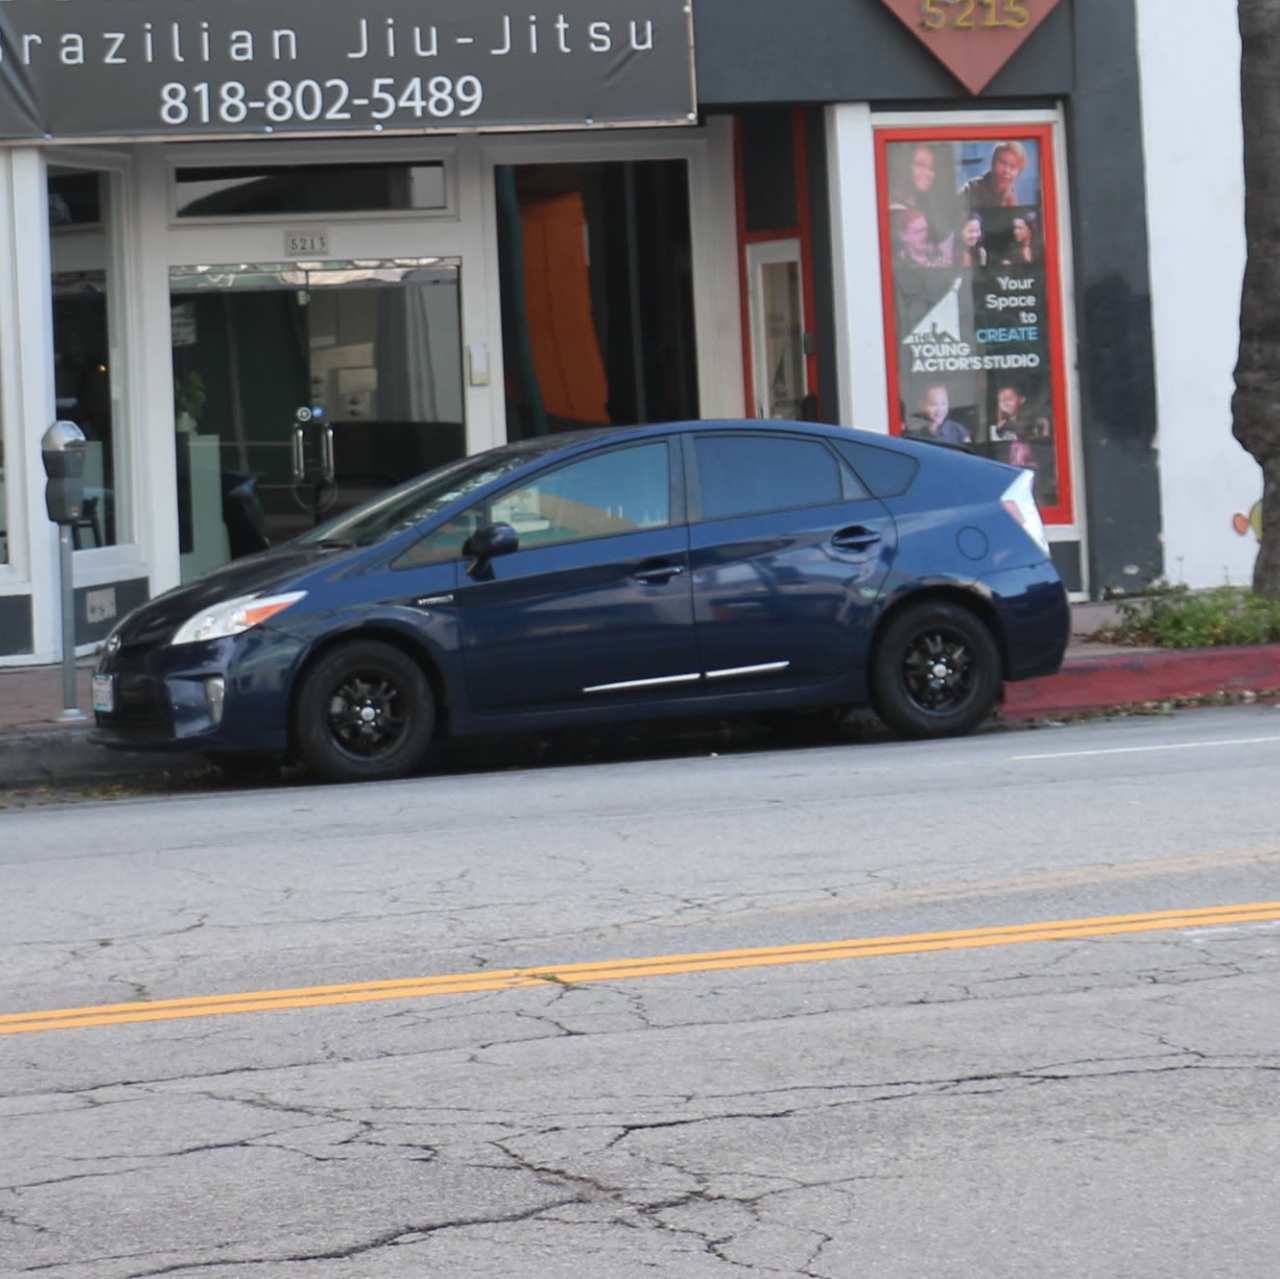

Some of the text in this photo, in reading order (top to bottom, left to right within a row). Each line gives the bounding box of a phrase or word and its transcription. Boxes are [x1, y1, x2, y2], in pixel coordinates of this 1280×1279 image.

[346, 12, 654, 61] Jiu-Jitsu
[159, 74, 484, 125] 818-802-5489
[996, 276, 1035, 291] Your
[985, 294, 1037, 311] Space
[1019, 311, 1038, 324] to
[975, 326, 1039, 343] CREATE
[910, 342, 970, 358] YOUNG
[911, 353, 1040, 373] ACTOR'S STUDIO
